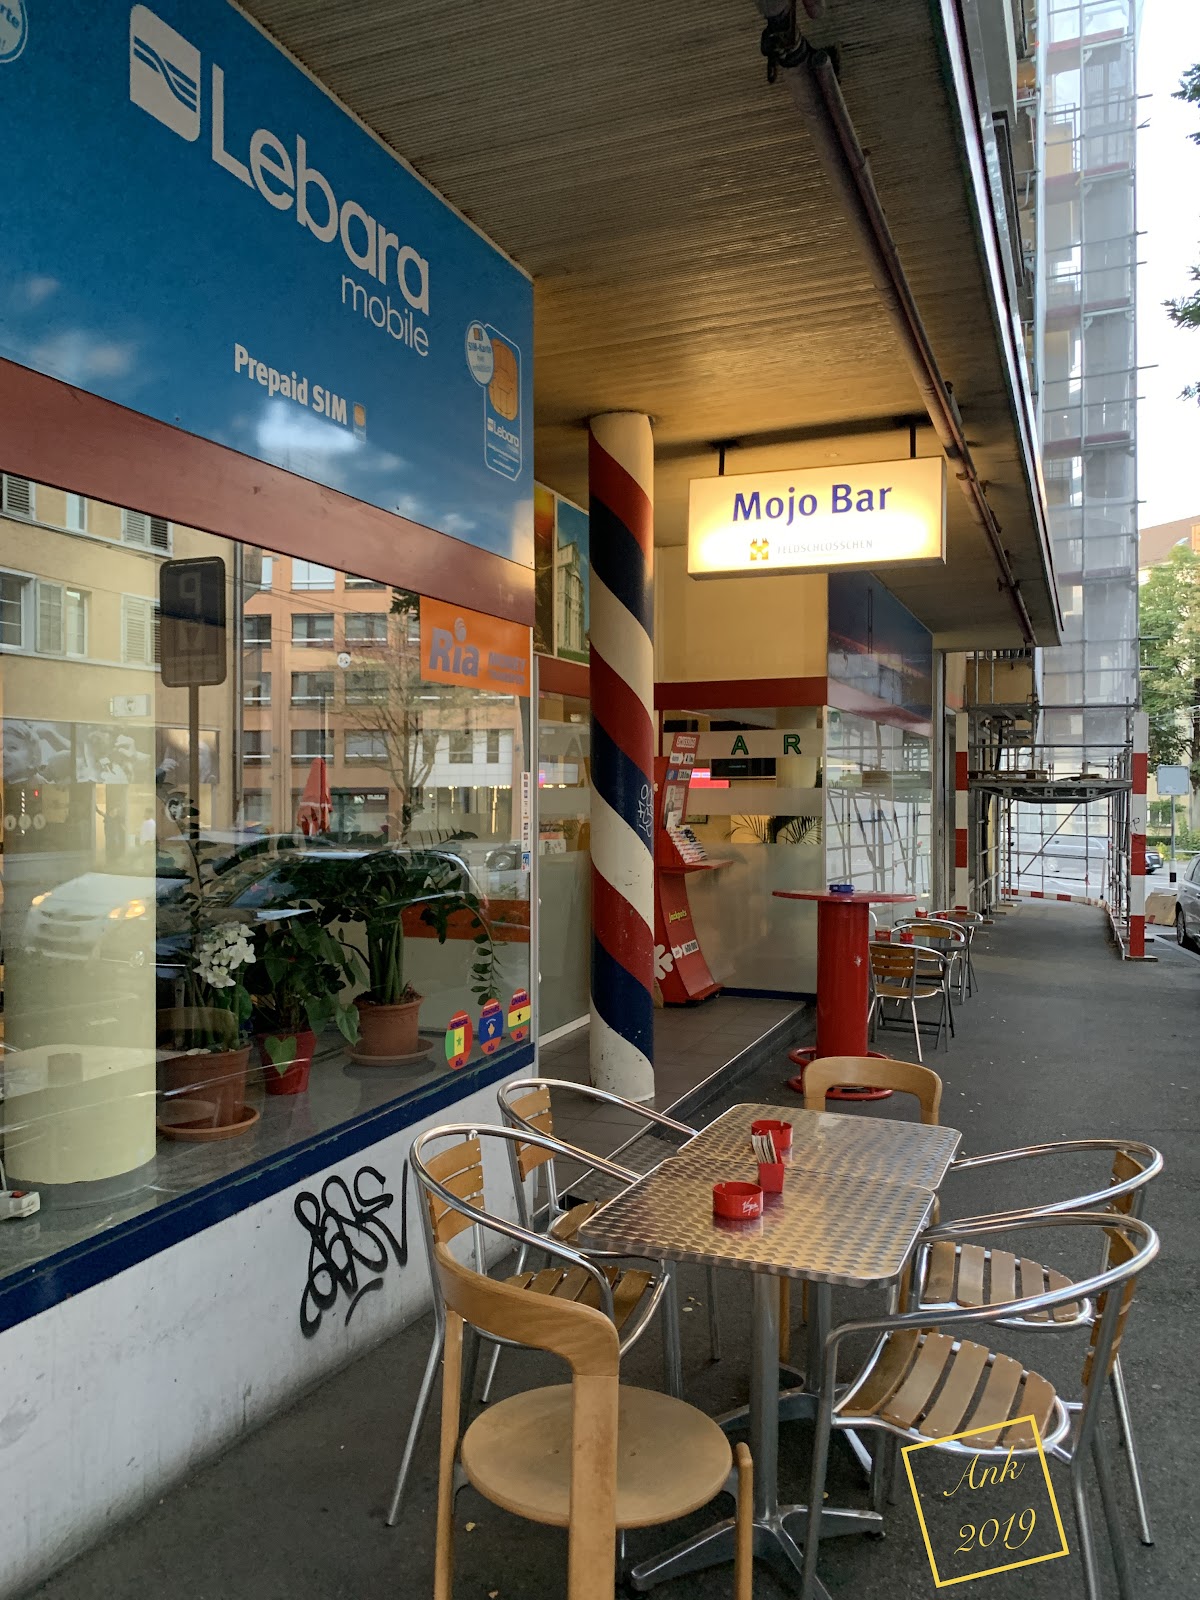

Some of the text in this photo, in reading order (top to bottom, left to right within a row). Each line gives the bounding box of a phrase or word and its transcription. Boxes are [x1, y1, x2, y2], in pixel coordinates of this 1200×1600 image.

[212, 63, 429, 316] Lebara
[341, 274, 429, 356] mobile
[234, 342, 348, 425] Prepaid SIM
[732, 483, 893, 526] Mojo Bar
[429, 618, 479, 677] Ria
